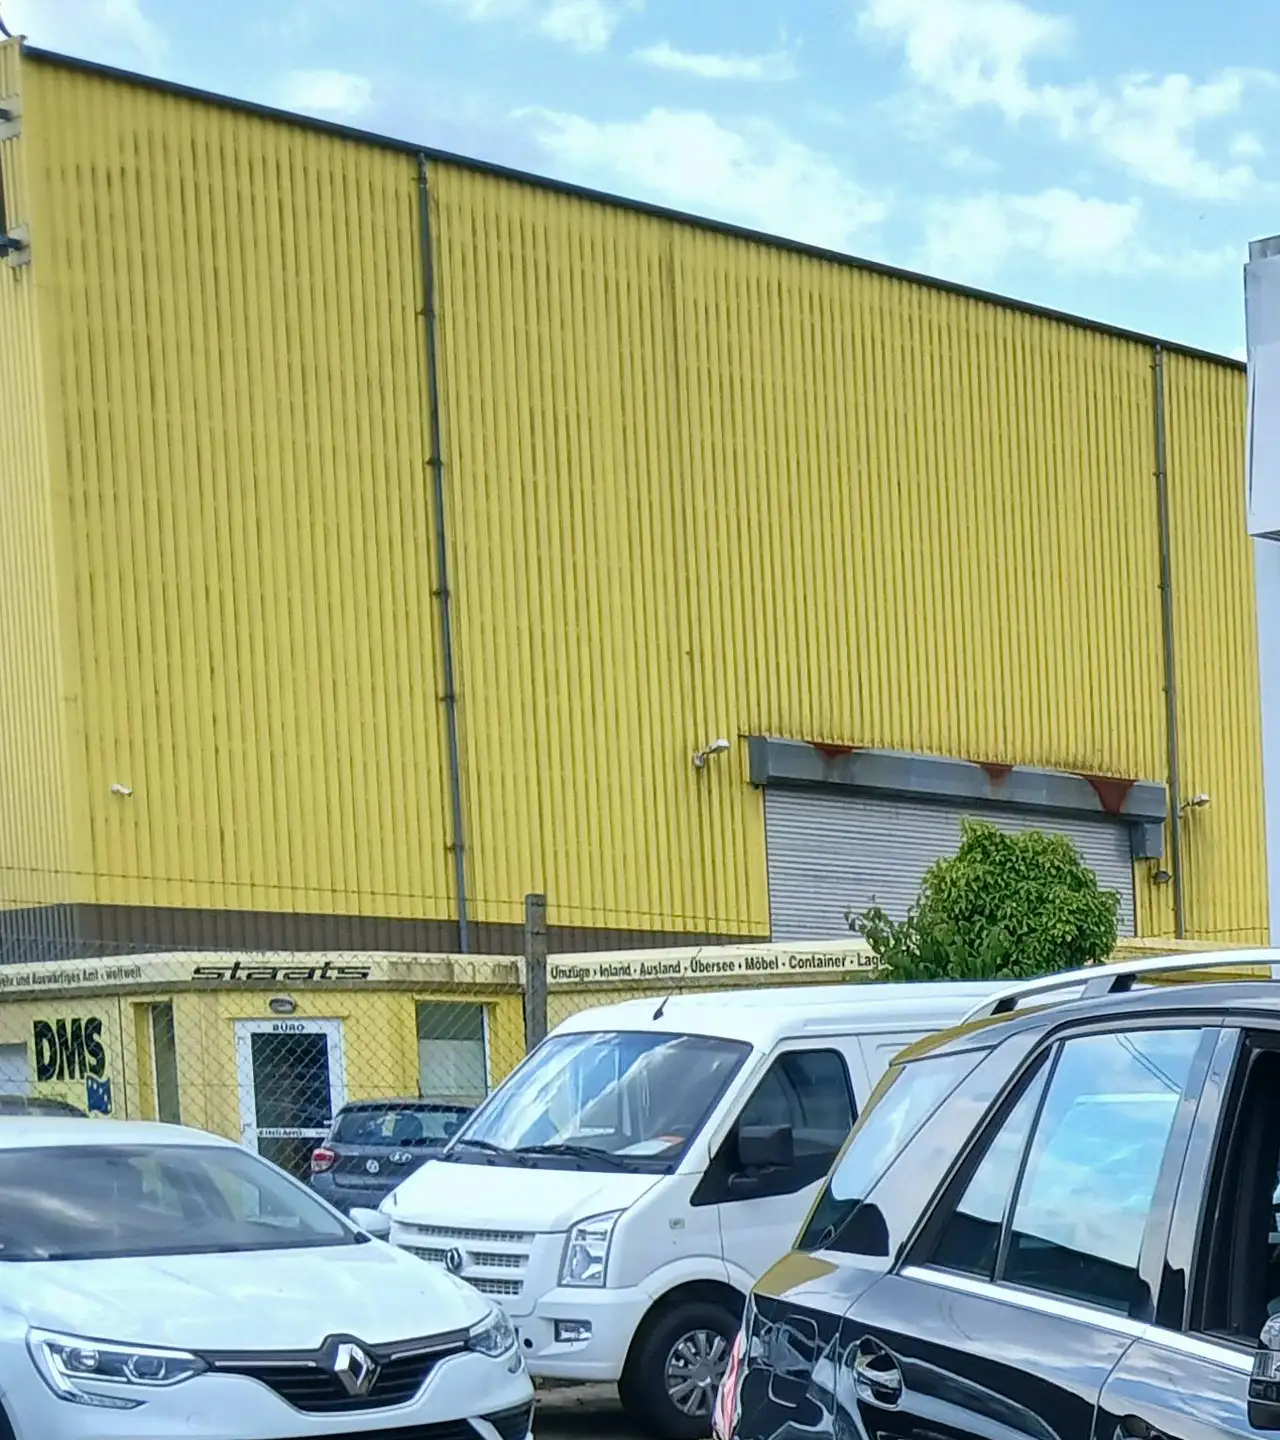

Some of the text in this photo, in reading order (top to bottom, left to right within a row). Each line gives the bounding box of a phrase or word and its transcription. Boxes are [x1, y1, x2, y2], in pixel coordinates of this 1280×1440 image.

[600, 963, 632, 979] Inland
[640, 960, 681, 977] Ausland
[690, 956, 735, 974] Übersee
[745, 955, 779, 971] Möbel
[789, 954, 848, 969] Container
[272, 1020, 305, 1032] BÜRO
[33, 1017, 106, 1083] DMS
